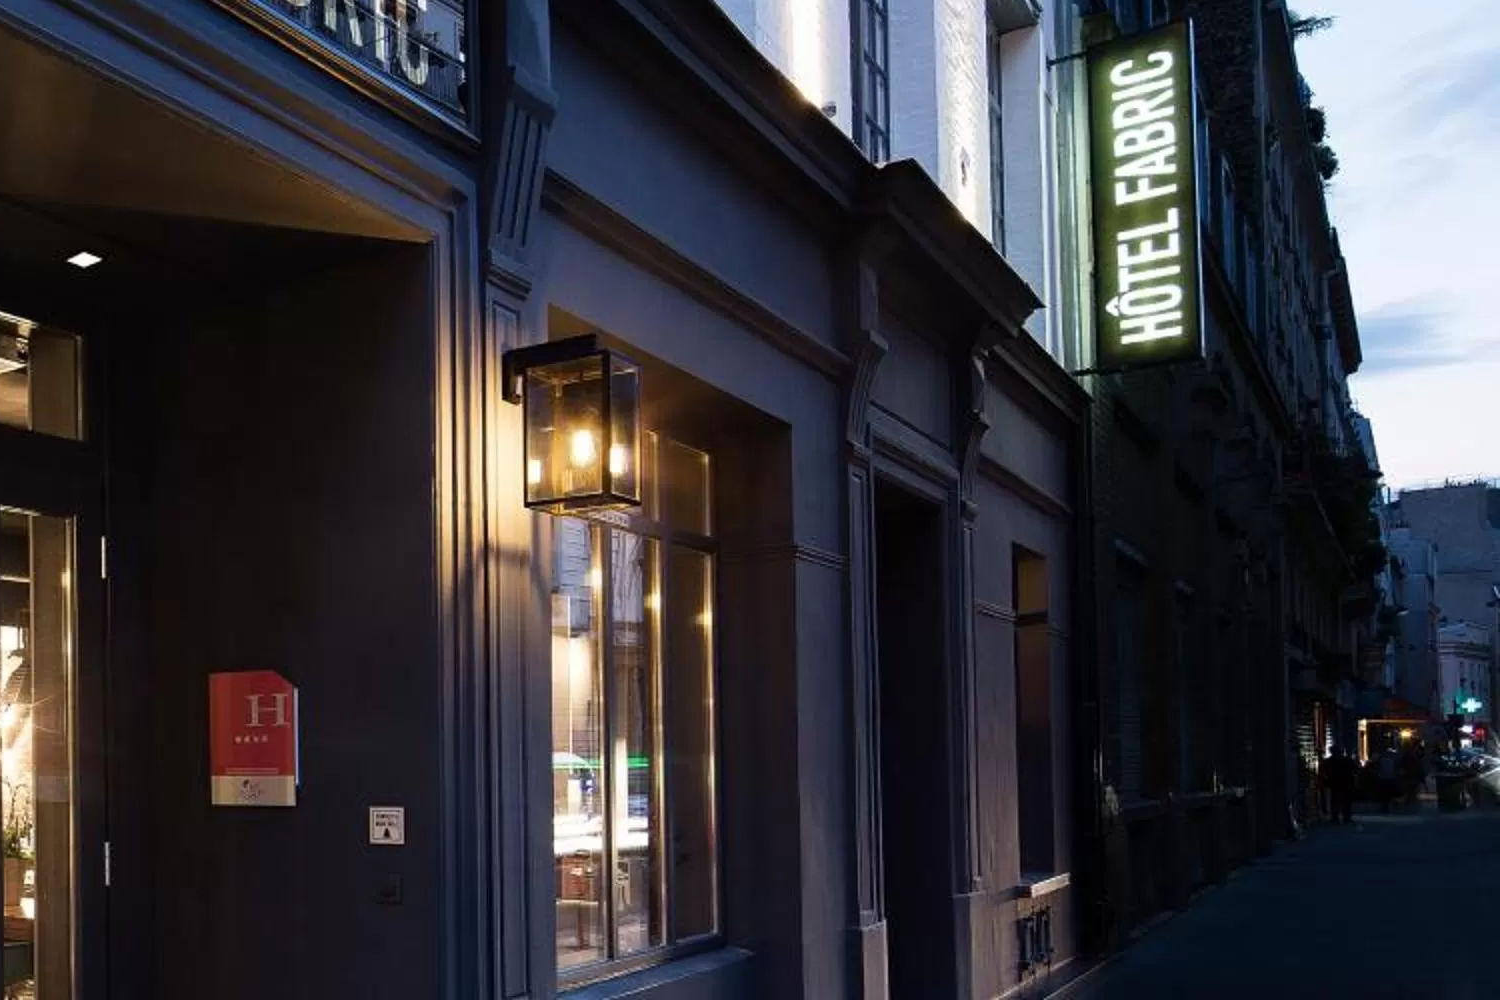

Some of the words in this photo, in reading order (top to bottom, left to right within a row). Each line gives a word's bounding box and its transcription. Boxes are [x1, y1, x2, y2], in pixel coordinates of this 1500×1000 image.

[1109, 50, 1179, 206] FABRIC
[1105, 207, 1184, 345] HÔTEL
[246, 693, 291, 727] H
